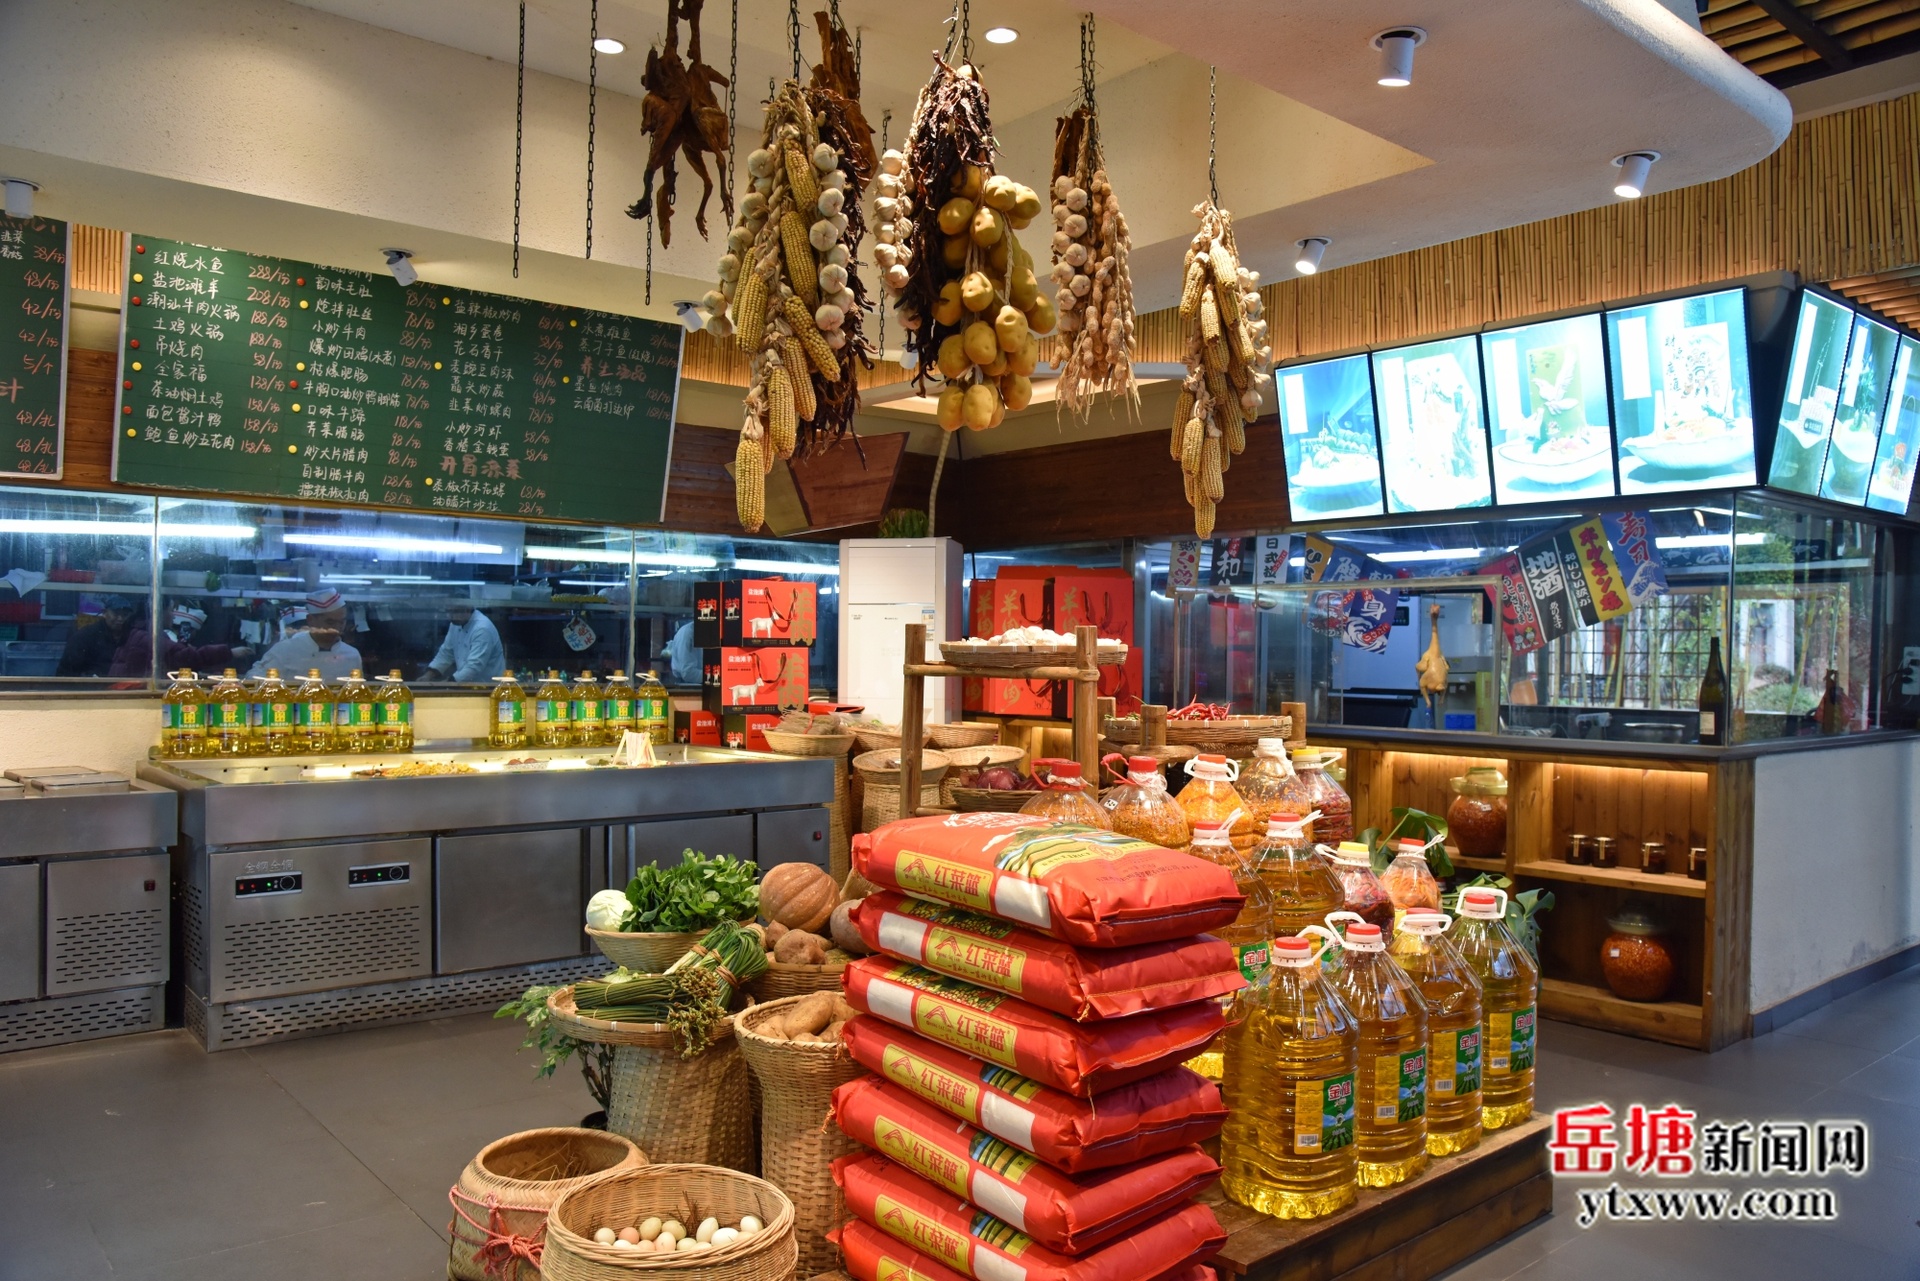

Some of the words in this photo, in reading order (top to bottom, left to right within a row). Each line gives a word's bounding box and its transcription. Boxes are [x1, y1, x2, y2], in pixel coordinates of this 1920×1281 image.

[153, 250, 225, 275] 红烧水鱼
[152, 270, 220, 300] 盐池滩羊
[146, 291, 241, 322] 潮汕牛肉火锅
[152, 316, 225, 342] 土鸡火锅
[312, 319, 367, 341] 小炒牛肉
[452, 321, 504, 342] 湘乡蛋卷
[155, 334, 204, 361] 吊烧肉
[453, 339, 504, 363] 花石香干
[154, 359, 208, 383] 全家福
[146, 404, 223, 428] 面包酱汁鸭
[143, 424, 236, 450] 鲍鱼炒五花肉
[444, 420, 503, 440] 小炒河虾
[303, 444, 369, 464] 炒大片腊肉
[302, 463, 366, 484] 自制腊牛肉
[1526, 551, 1564, 600] 地酒
[934, 864, 982, 897] 红菜篮
[965, 943, 1014, 978] 红菜篮
[956, 1014, 1006, 1053] 红菜篮
[920, 1067, 969, 1109] 红菜篮
[913, 1141, 960, 1186] 红菜篮
[913, 1219, 960, 1263] 红菜篮
